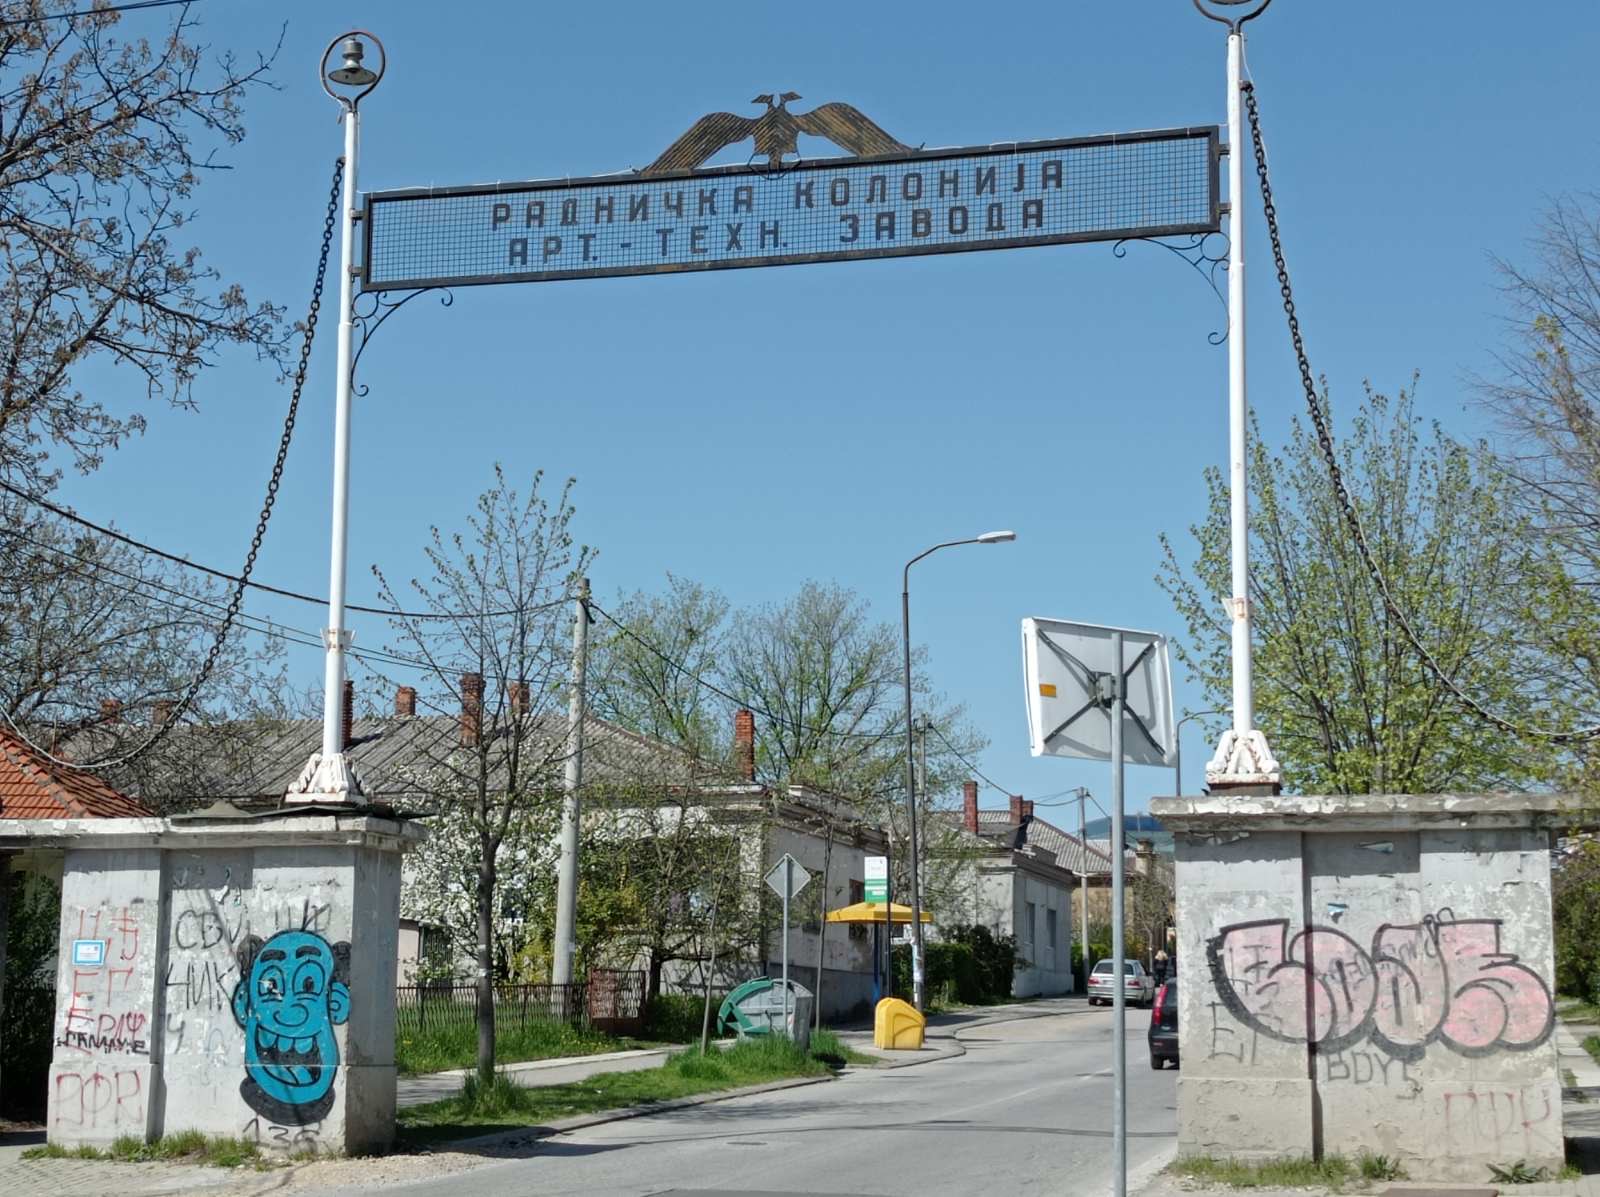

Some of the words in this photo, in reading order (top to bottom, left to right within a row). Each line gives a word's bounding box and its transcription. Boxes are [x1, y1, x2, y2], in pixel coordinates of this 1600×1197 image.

[492, 185, 753, 231] РАДНИЧКА
[794, 159, 1063, 209] КОЛОНИЈА
[839, 199, 1044, 243] ЗАВОДА
